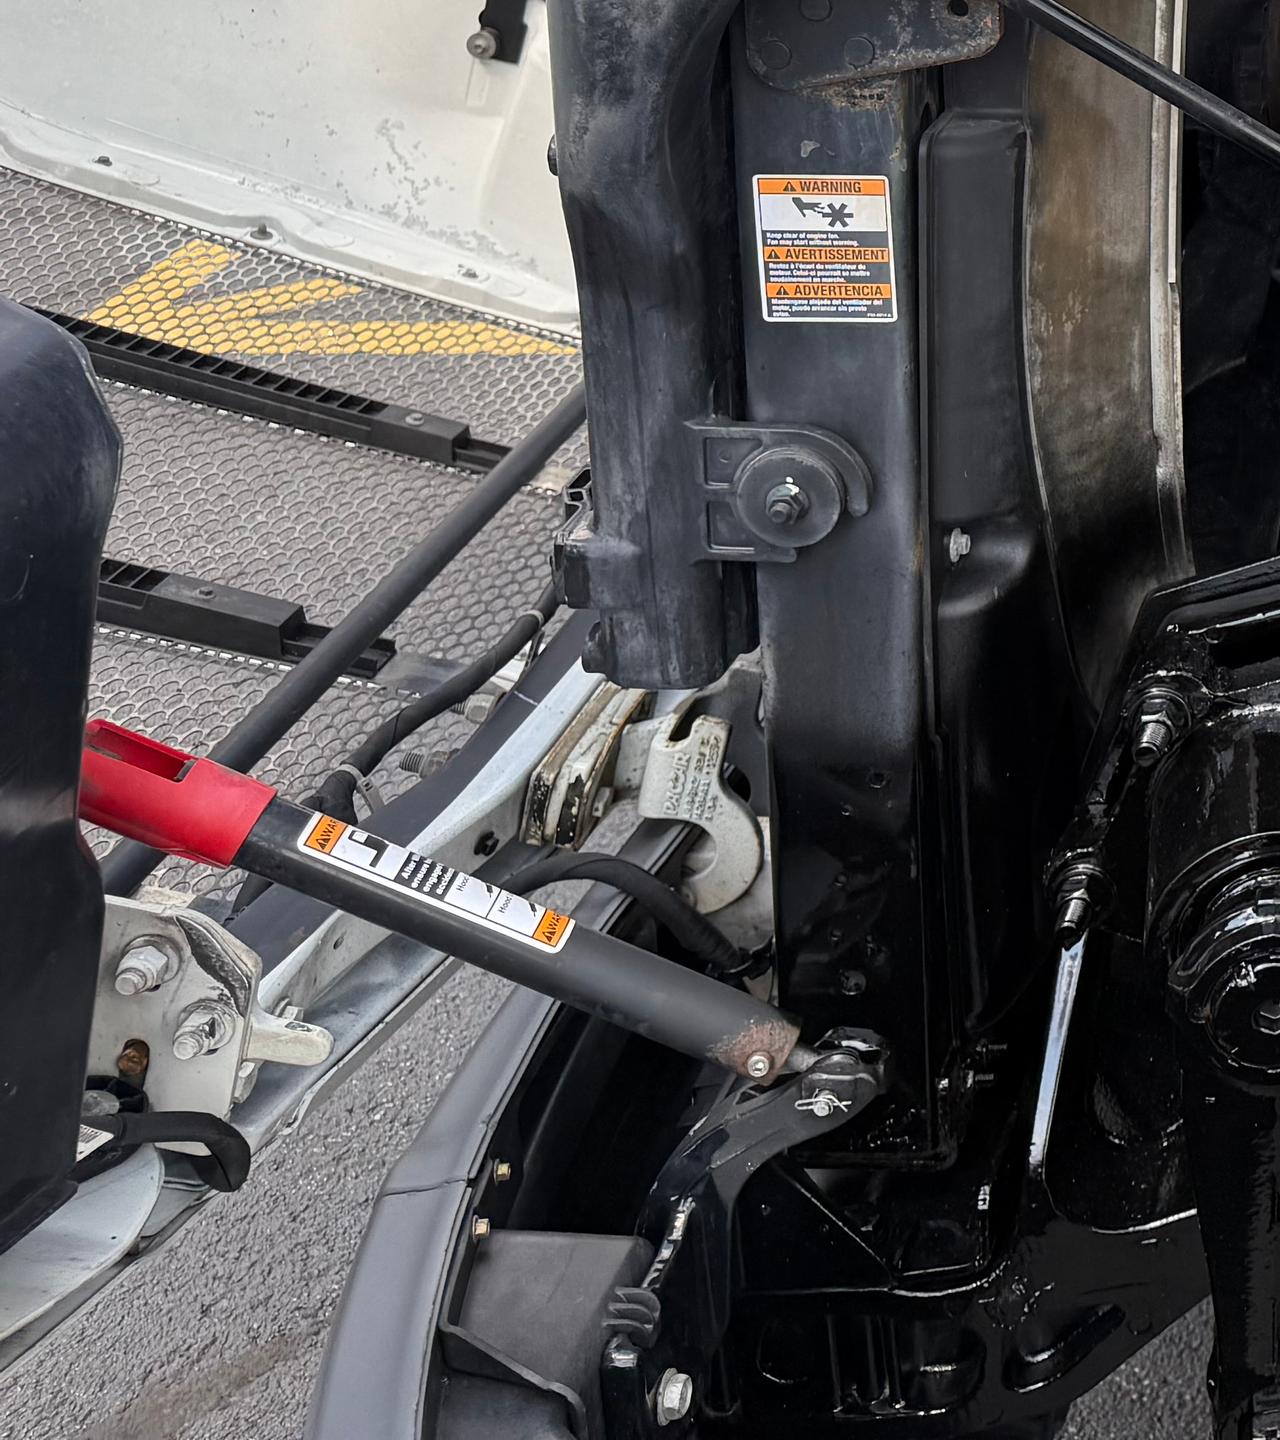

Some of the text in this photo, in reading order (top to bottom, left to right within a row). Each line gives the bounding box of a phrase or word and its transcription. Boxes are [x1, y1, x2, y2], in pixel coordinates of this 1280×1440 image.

[800, 182, 862, 193] WARNING
[785, 248, 886, 260] AVERTISSEMENT
[794, 285, 883, 296] ADVERTENCIA
